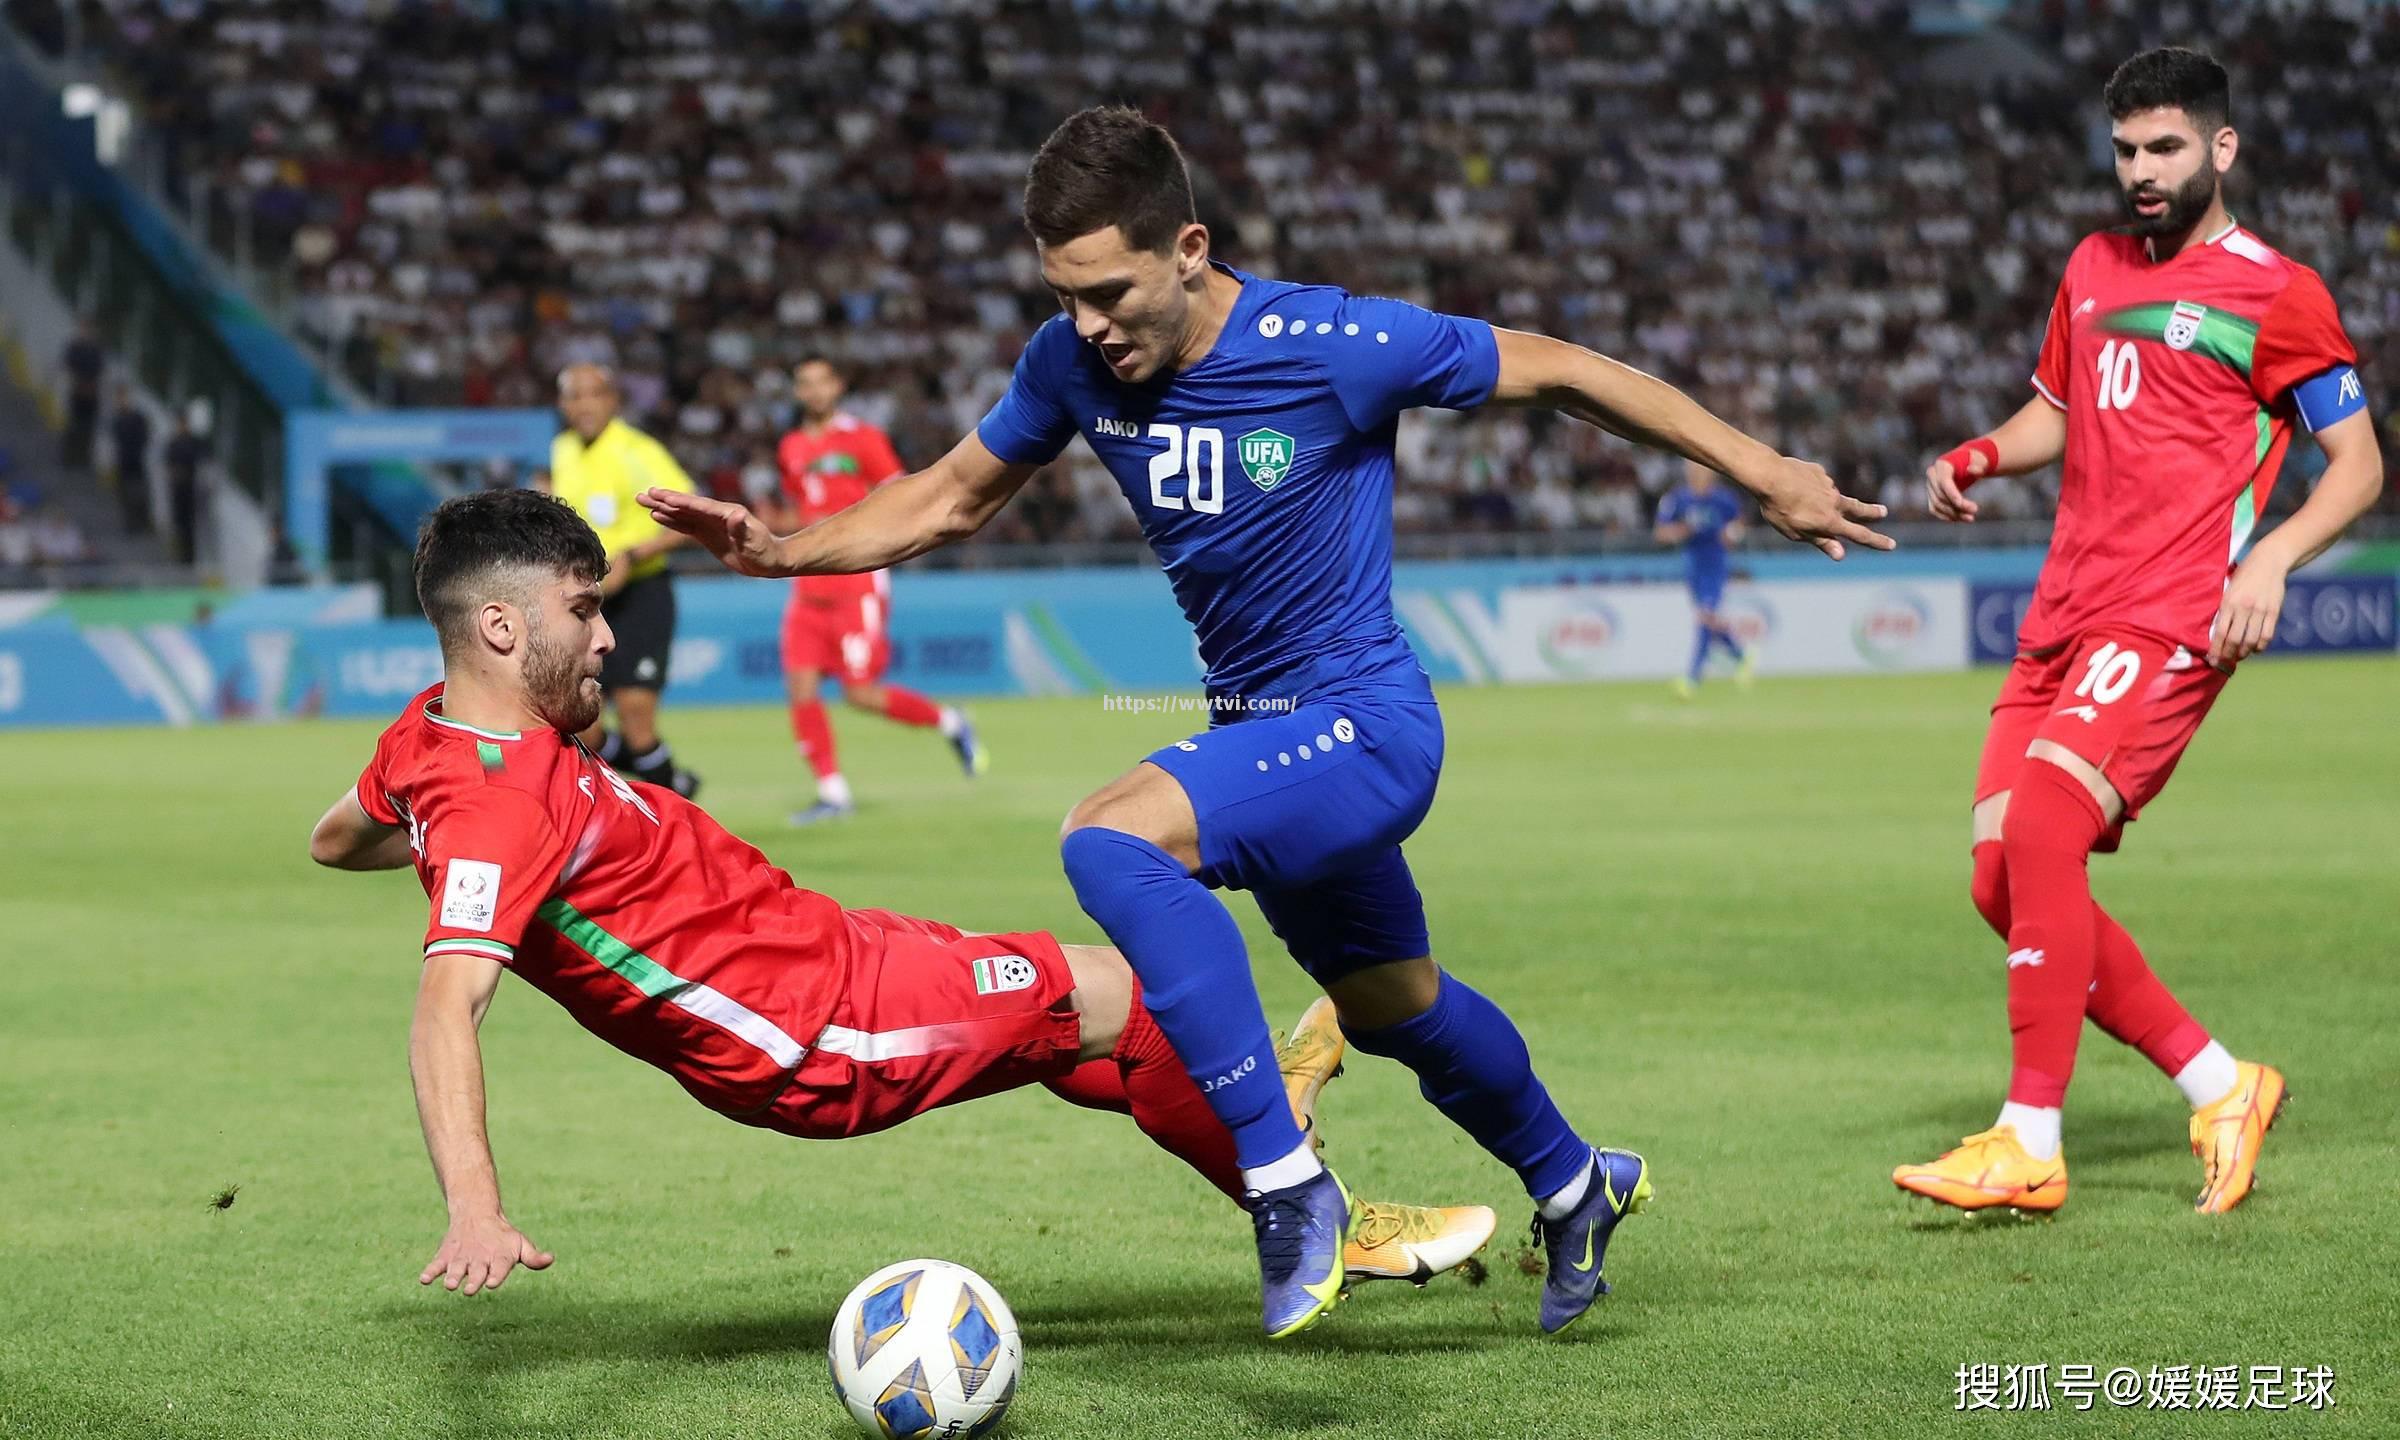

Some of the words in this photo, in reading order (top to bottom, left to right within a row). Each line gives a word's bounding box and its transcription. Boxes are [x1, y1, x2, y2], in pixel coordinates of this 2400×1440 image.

[2097, 339, 2141, 411] 10
[1095, 416, 1138, 438] JAKO
[1245, 441, 1287, 464] UFA
[1147, 423, 1224, 515] 20
[2074, 641, 2141, 705] 10
[1203, 1055, 1257, 1093] JAKO
